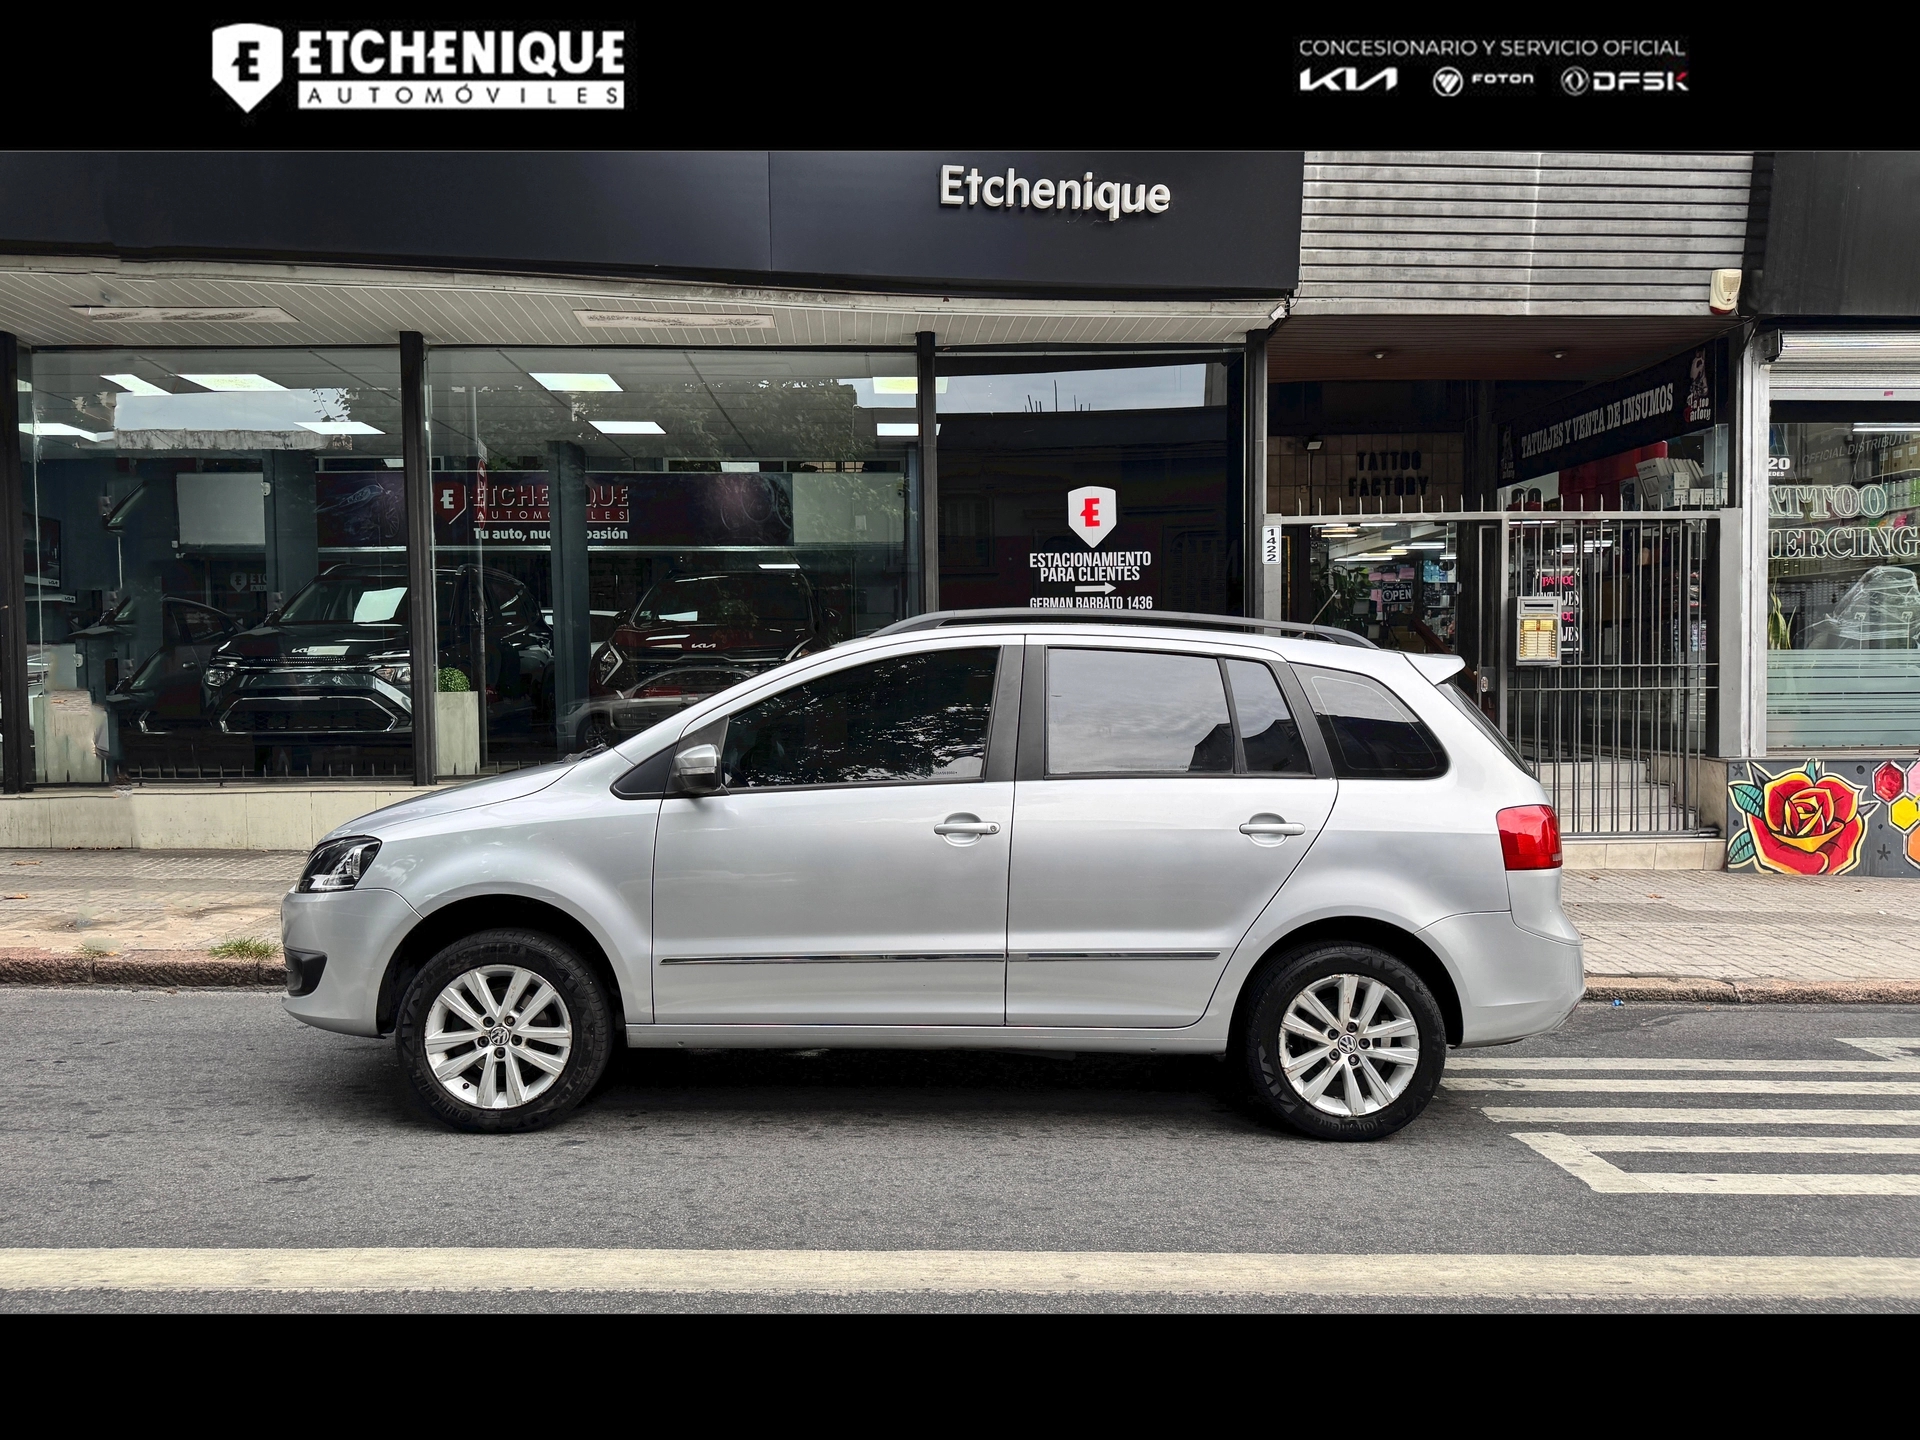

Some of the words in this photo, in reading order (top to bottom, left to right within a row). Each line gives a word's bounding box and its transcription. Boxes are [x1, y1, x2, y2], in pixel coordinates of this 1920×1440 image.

[940, 164, 1171, 222] Etchenique
[1521, 421, 1564, 459] TATUAJES
[1564, 419, 1572, 444] Y
[1572, 407, 1606, 441] VENTA
[1606, 400, 1621, 430] DE
[1621, 382, 1674, 425] INSUMOS
[1802, 445, 1845, 465] OFFICIAL
[1847, 432, 1910, 455] DISTRIBUTO
[1357, 450, 1421, 471] TATTOO
[1348, 476, 1428, 497] FACTORY
[1768, 484, 1888, 519] ATTOO
[477, 510, 625, 520] AUTOMLES
[473, 527, 489, 540] Tu
[492, 528, 527, 542] auto,
[1266, 528, 1277, 562] 1422
[1768, 526, 1920, 560] IERCING
[1029, 551, 1152, 568] ESTACIONAMIENTO
[1040, 567, 1075, 582] PARA
[1078, 565, 1140, 582] CLIENTES
[1029, 597, 1073, 609] GERMAN
[1075, 596, 1123, 609] BARBATO
[1126, 596, 1153, 609] 1436
[1382, 589, 1412, 602] OPEN
